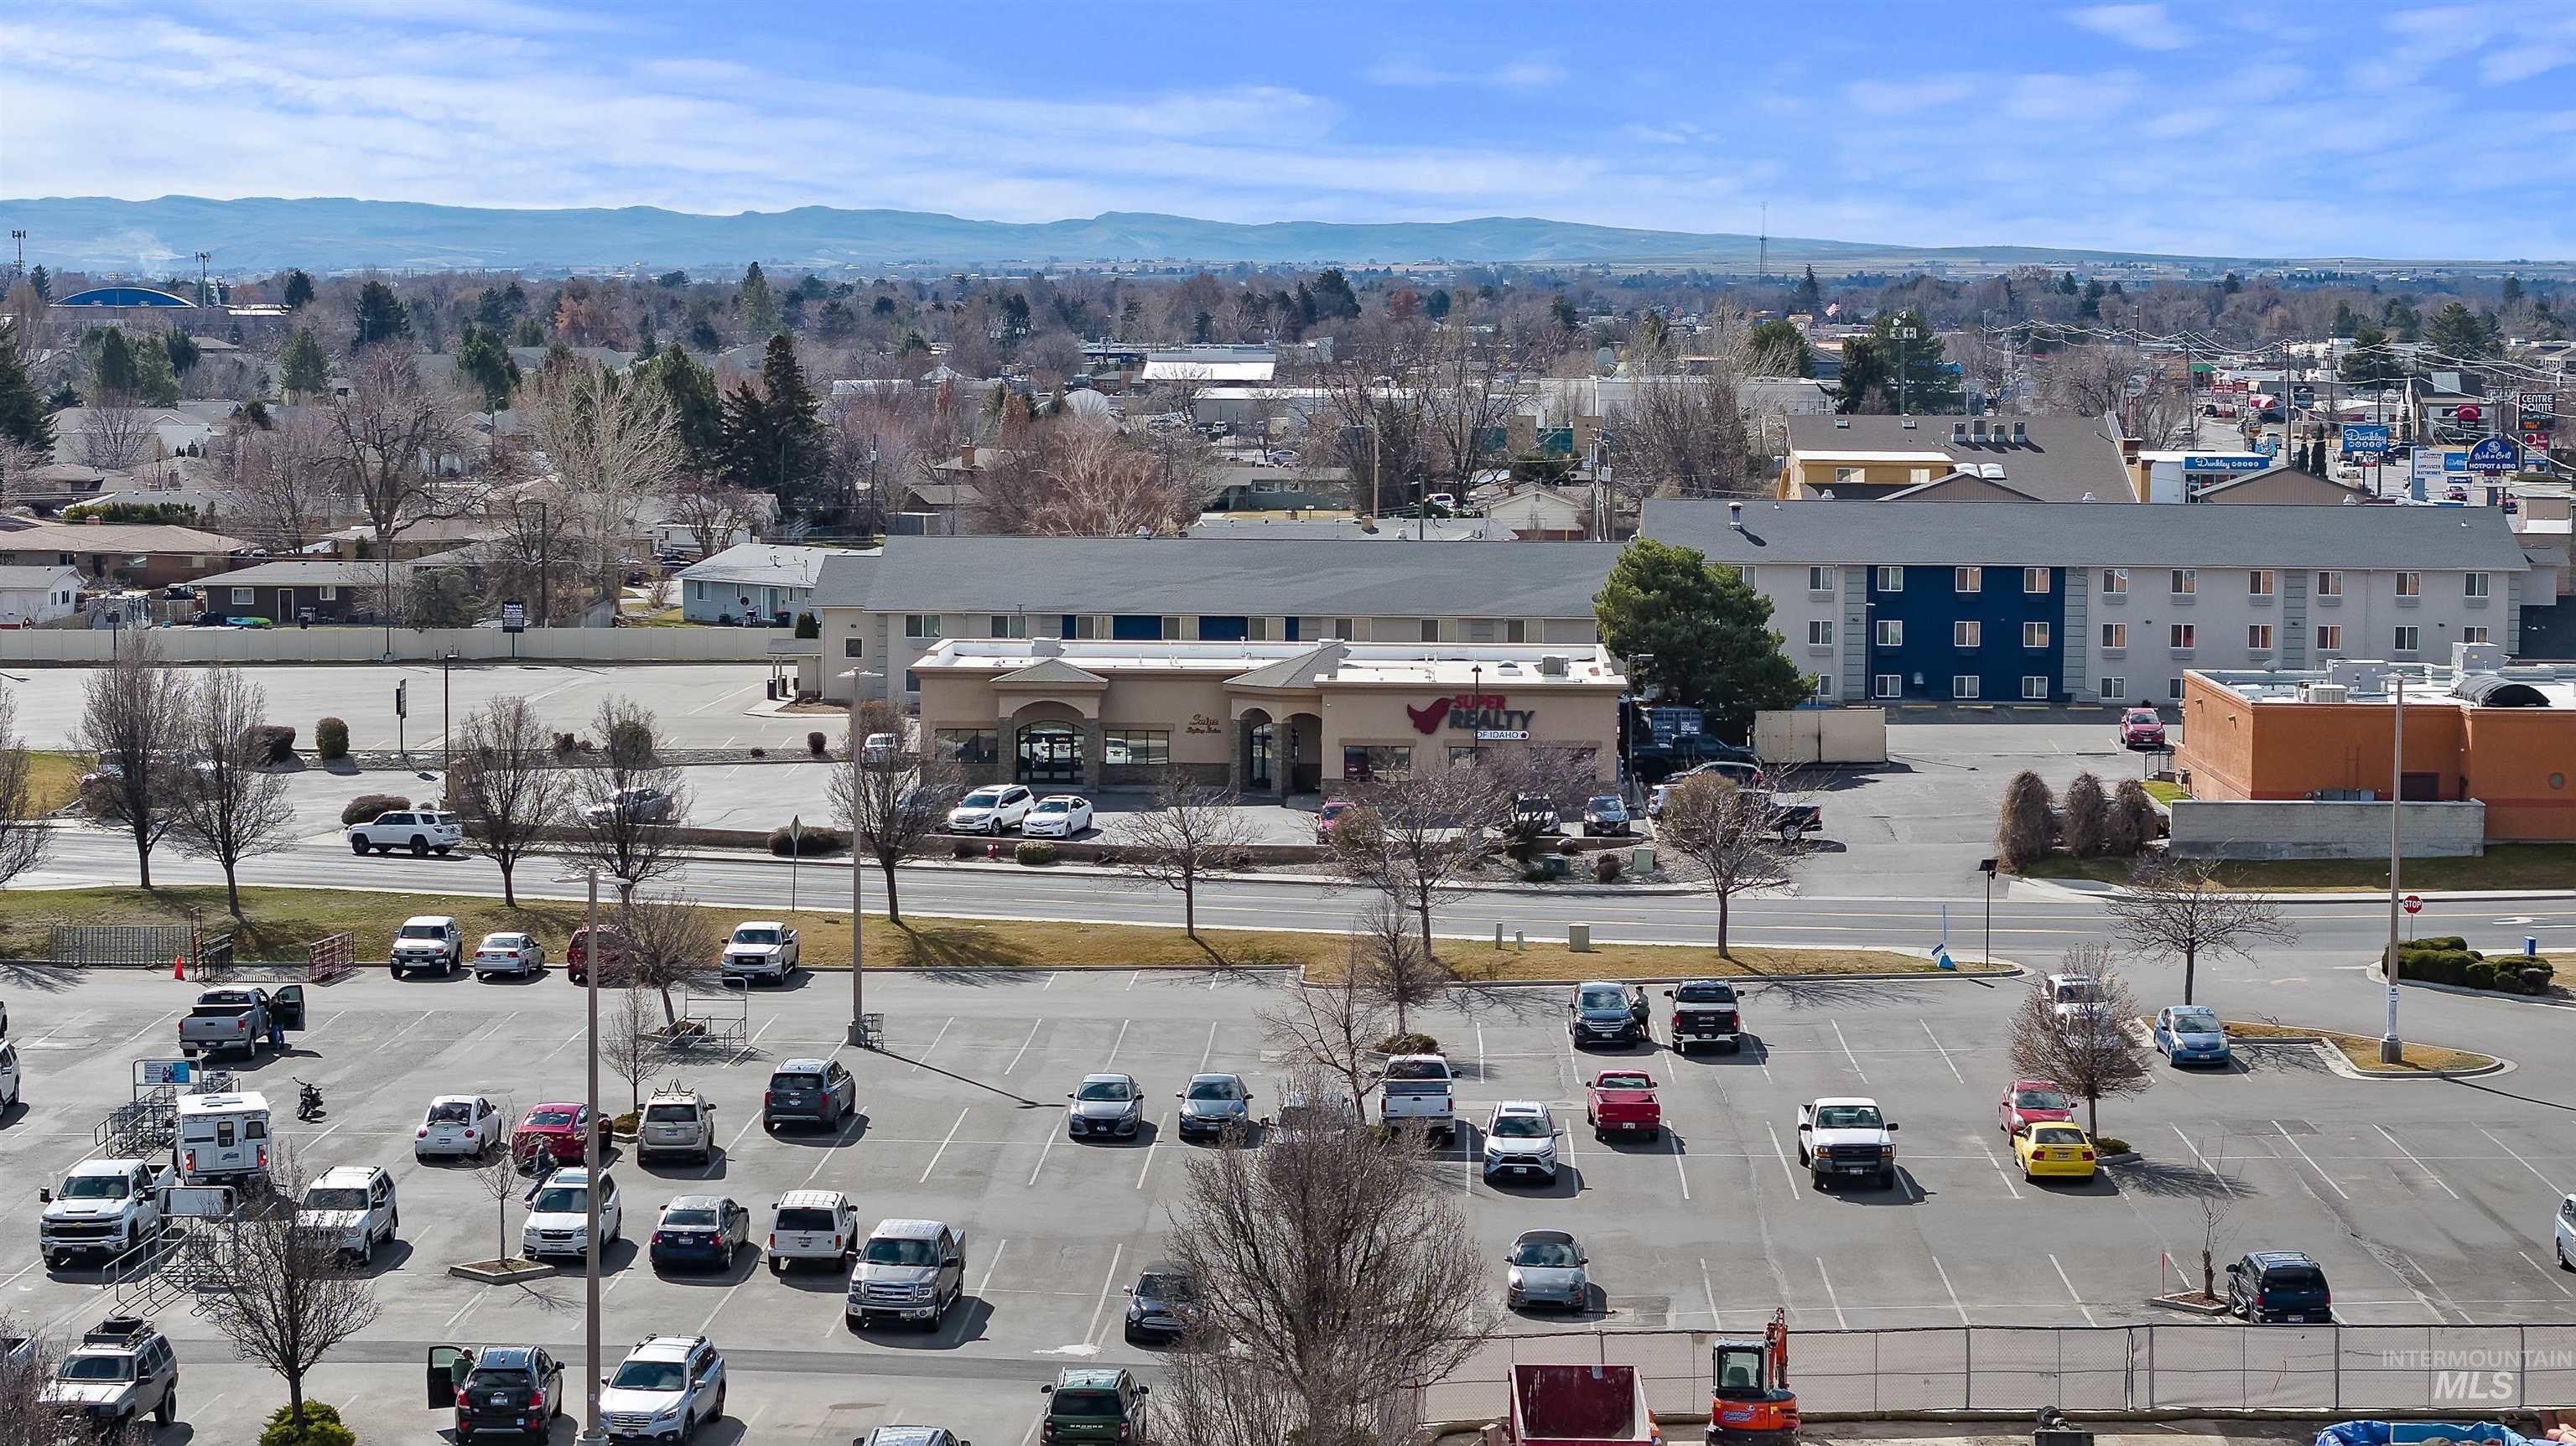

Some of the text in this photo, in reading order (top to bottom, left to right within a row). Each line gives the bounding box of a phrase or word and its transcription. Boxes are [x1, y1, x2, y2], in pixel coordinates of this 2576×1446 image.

[2521, 394, 2553, 402] CENTRE
[2521, 403, 2553, 412] POINTE
[2344, 428, 2387, 444] Dunkley
[2194, 457, 2231, 469] Dunkley
[1455, 695, 1505, 709] SUPER
[1449, 710, 1535, 729] REALTY
[2404, 899, 2422, 909] STOP
